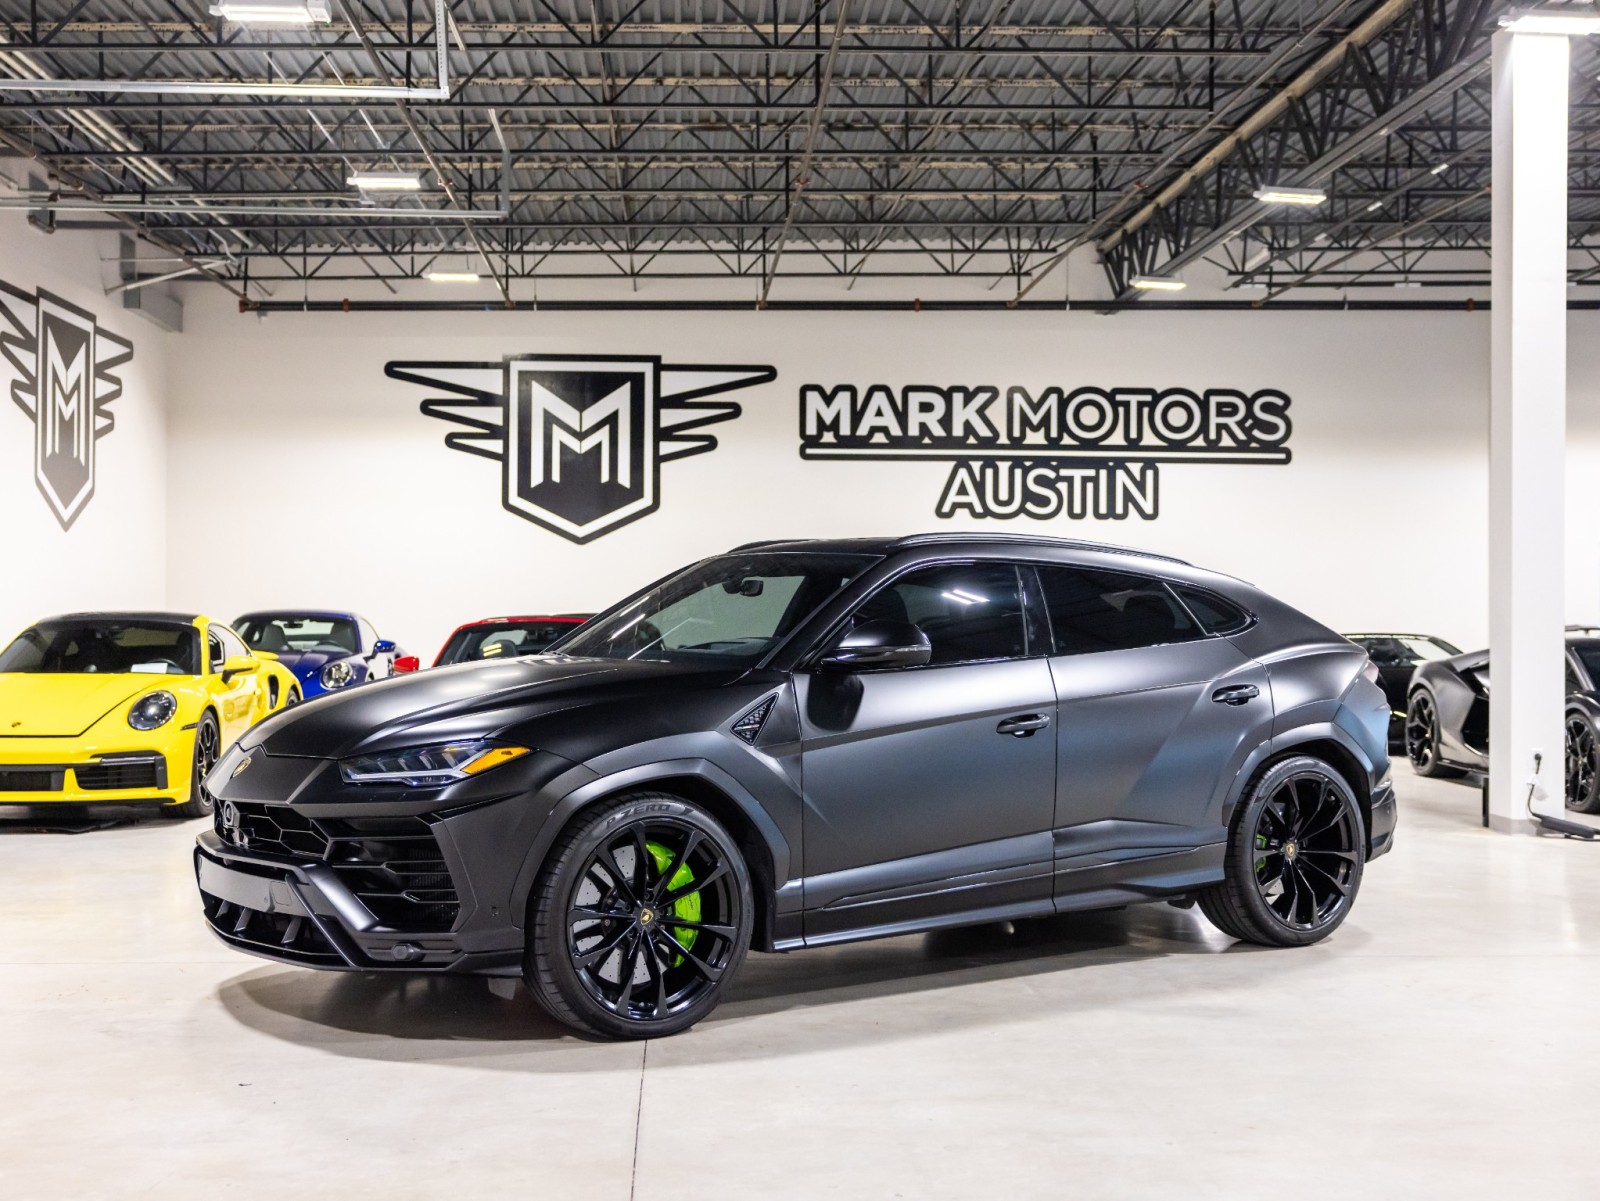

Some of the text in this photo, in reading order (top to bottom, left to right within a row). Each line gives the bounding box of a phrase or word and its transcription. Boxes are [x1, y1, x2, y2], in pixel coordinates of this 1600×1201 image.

[802, 387, 1290, 444] MARK MOTORS
[938, 464, 1157, 518] AUSTIN
[606, 804, 671, 829] P ZERO
